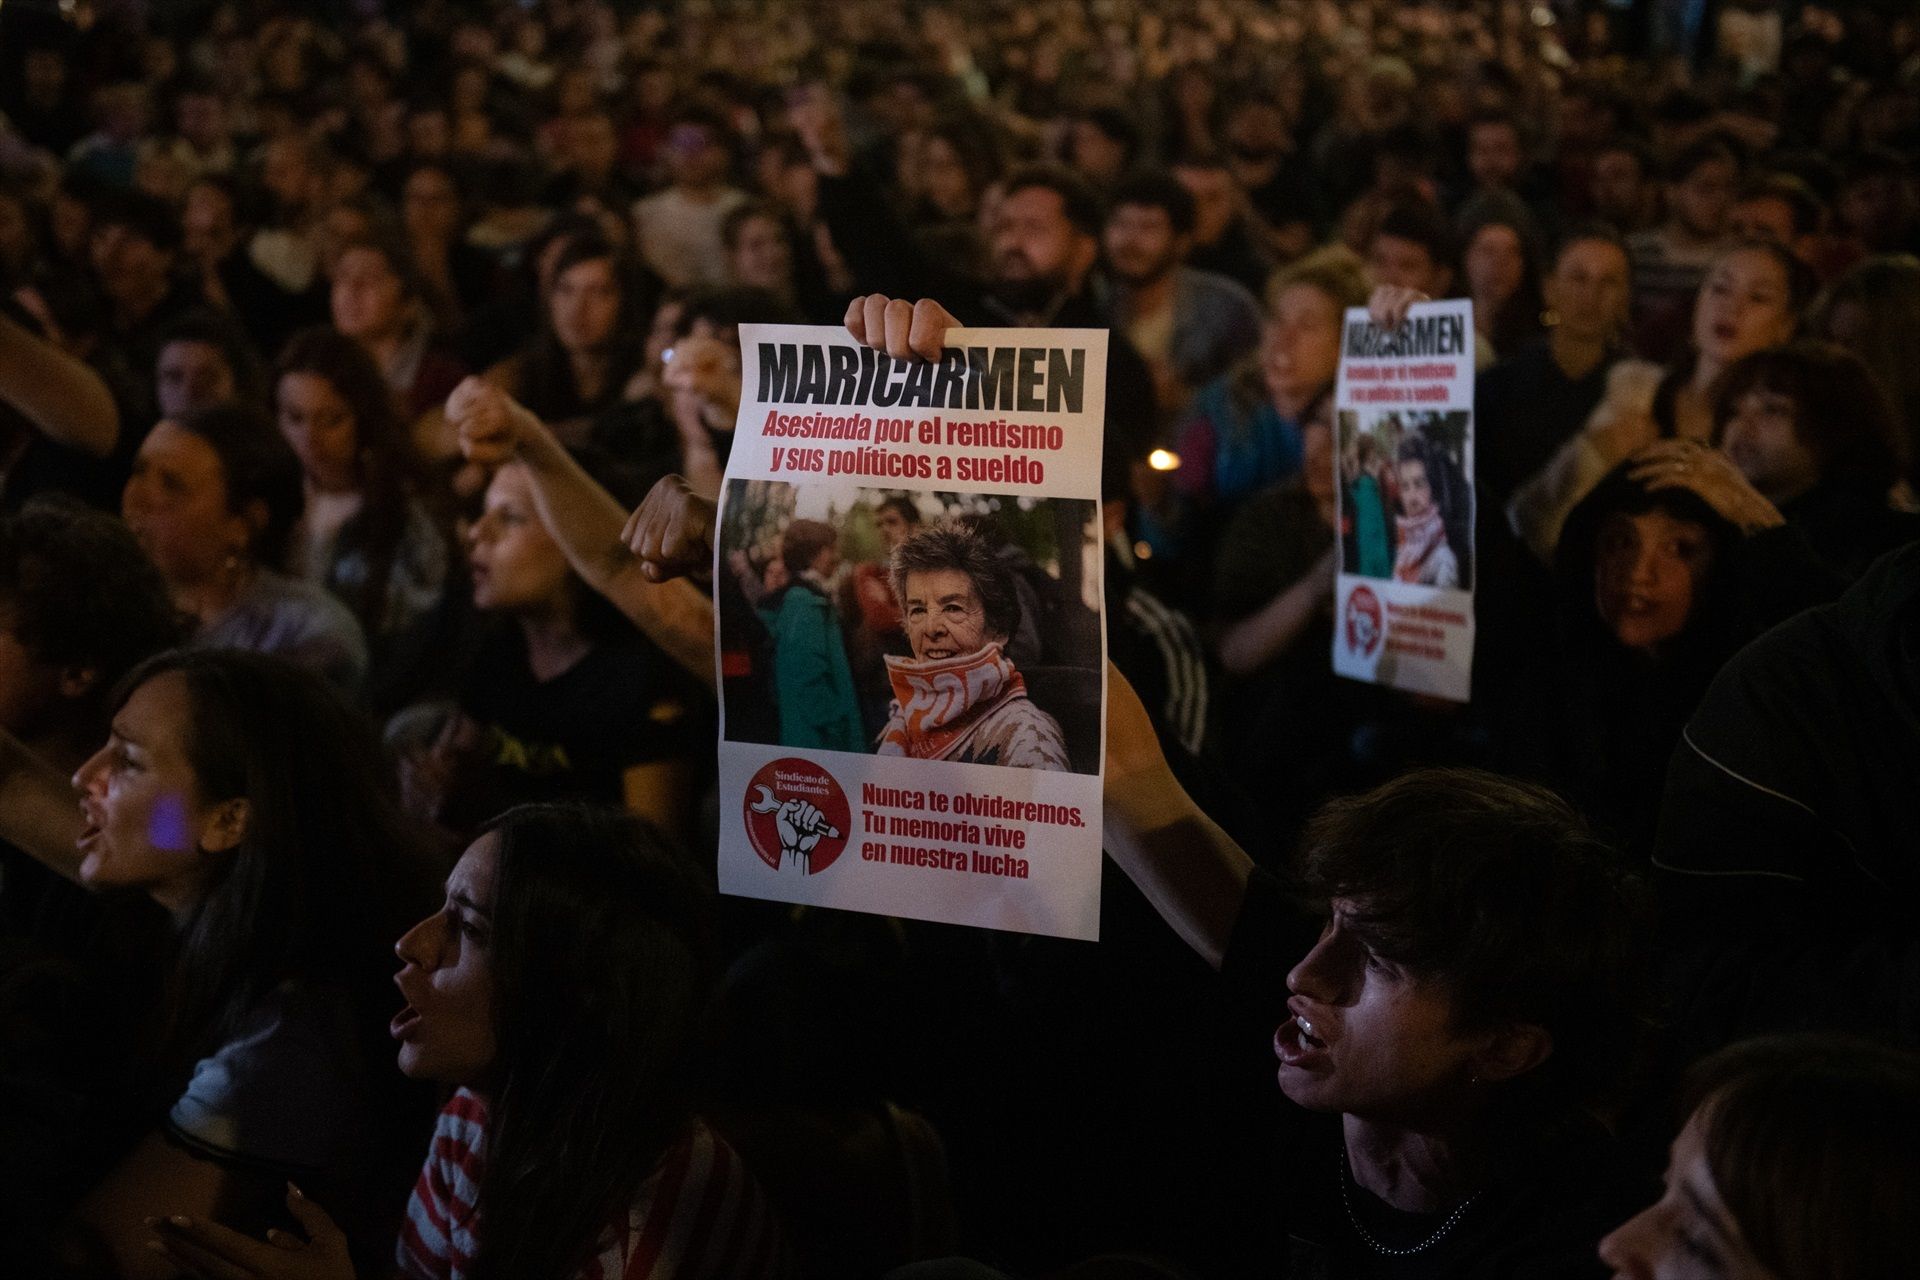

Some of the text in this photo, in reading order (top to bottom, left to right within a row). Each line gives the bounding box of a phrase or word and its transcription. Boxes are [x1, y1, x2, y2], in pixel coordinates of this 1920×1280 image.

[757, 343, 1086, 413] MARICARMEN
[762, 410, 1064, 450] Asesinada por el rentismo
[770, 446, 1044, 485] y sus políticos a sueldo
[775, 770, 830, 785] Sindicato de
[776, 781, 830, 796] Estudiantes
[862, 783, 1086, 828] Nunca te olvidaremos.
[862, 810, 1026, 849] Tu memoria vive
[862, 842, 1029, 879] en nuestra lucha
